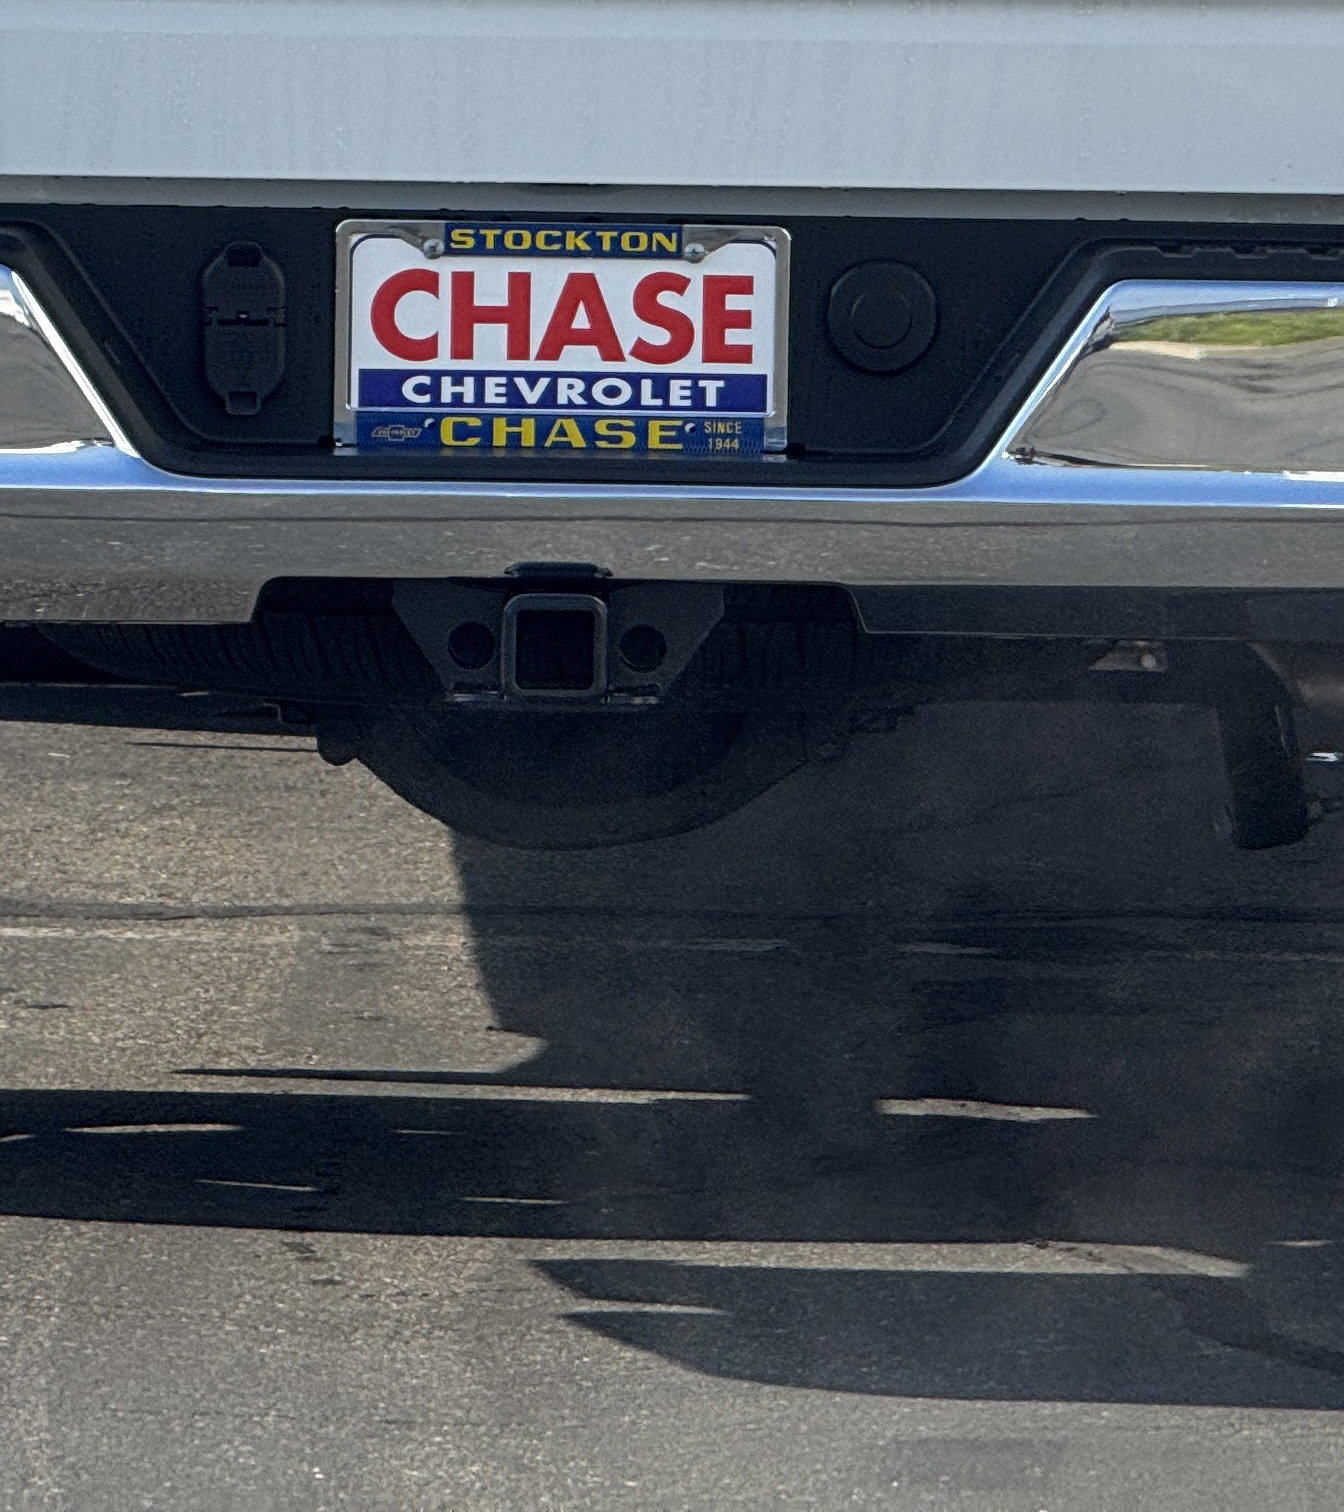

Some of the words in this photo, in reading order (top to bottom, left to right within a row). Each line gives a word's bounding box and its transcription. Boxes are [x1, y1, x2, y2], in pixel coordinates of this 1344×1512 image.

[451, 229, 678, 253] STOCKTON
[371, 268, 754, 364] CHASE
[402, 376, 725, 407] CHEVROLET
[441, 418, 684, 450] CHASE
[704, 421, 742, 434] SINCE
[708, 437, 739, 450] 1944
